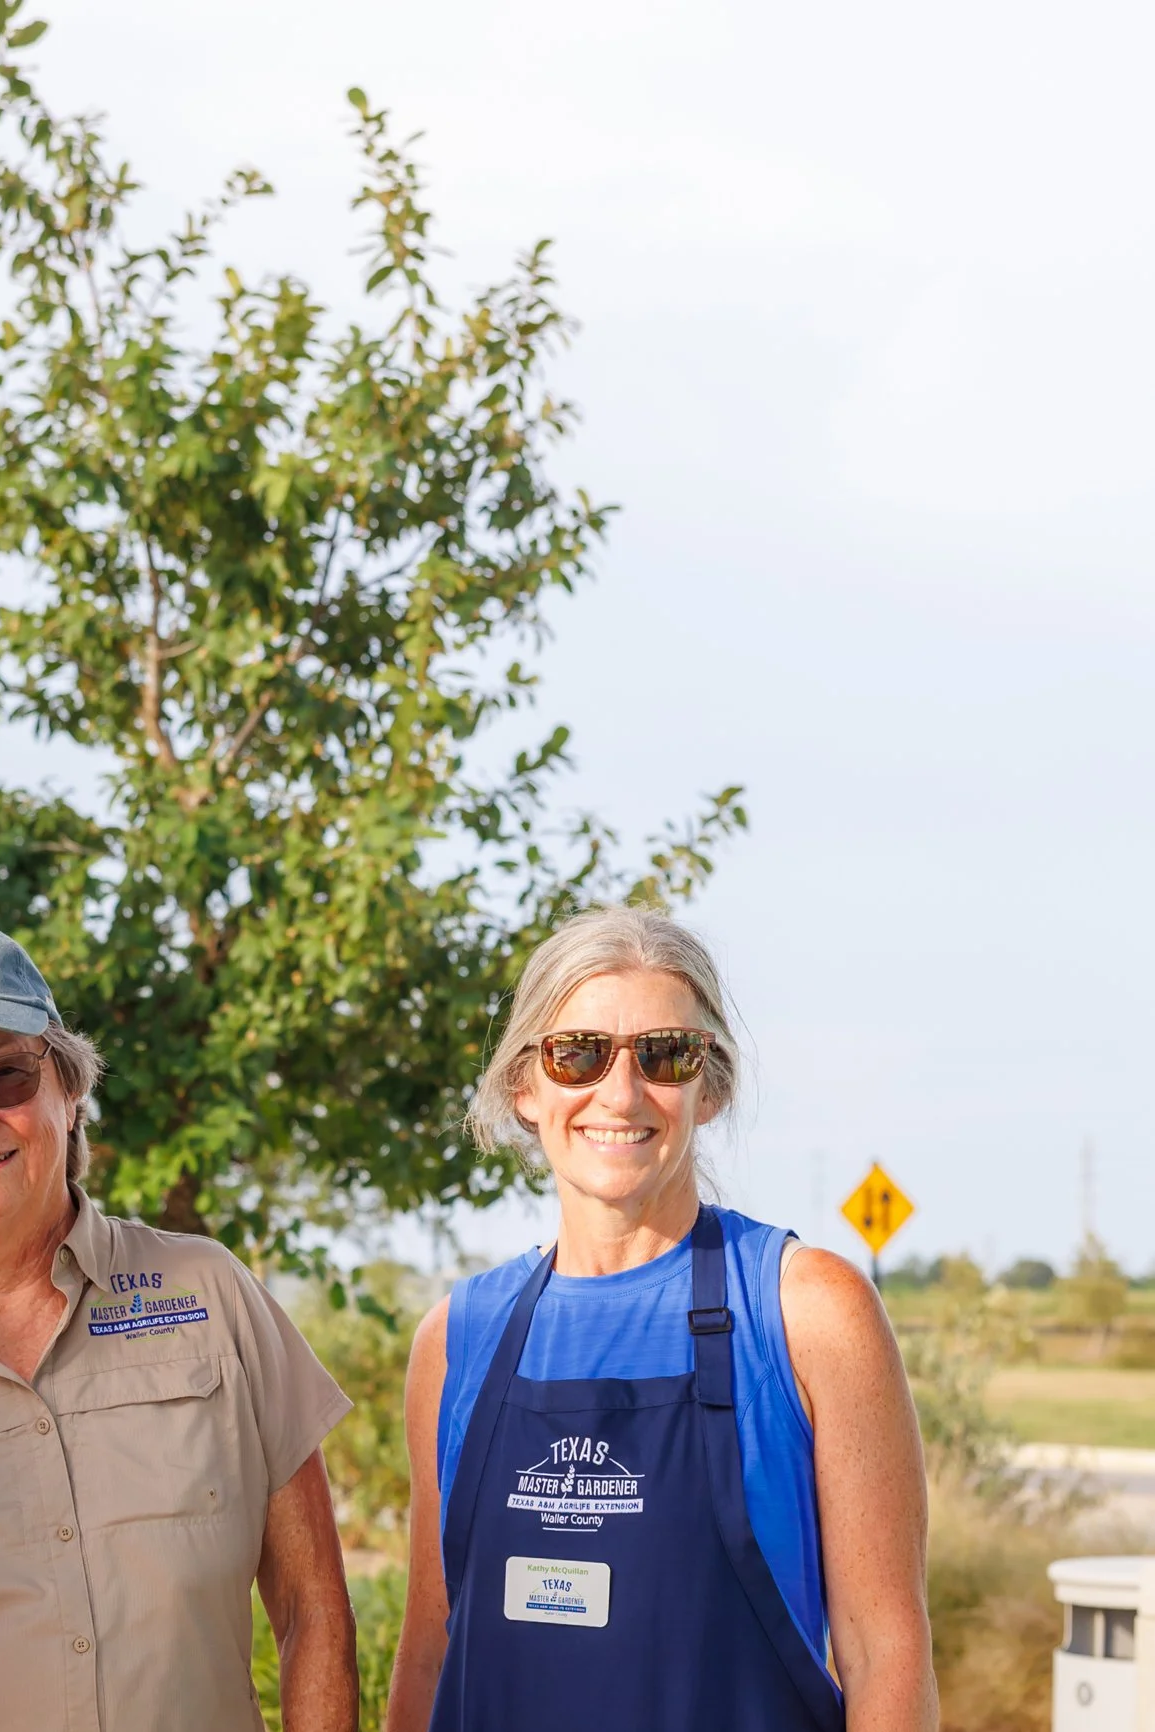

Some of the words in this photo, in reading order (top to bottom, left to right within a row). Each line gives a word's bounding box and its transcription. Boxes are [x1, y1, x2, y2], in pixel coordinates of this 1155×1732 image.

[110, 1272, 163, 1294] TEXAS
[90, 1305, 127, 1321] MASTER
[144, 1294, 198, 1314] GARDENER
[92, 1325, 112, 1334] TEXAS
[114, 1323, 131, 1332] A&M
[132, 1316, 164, 1328] AGRILIFE
[164, 1312, 206, 1324] EXTENSION
[125, 1331, 146, 1340] Waller
[150, 1326, 175, 1336] County
[550, 1436, 610, 1465] TEXAS
[518, 1476, 558, 1494] MASTER
[577, 1480, 638, 1496] GARDENER
[512, 1498, 534, 1506] TEXAS
[538, 1500, 554, 1509] A&M
[558, 1502, 590, 1510] AGRILIFE
[595, 1502, 639, 1510] EXTENSION
[540, 1512, 568, 1524] Waller
[571, 1514, 604, 1527] County
[528, 1564, 550, 1574] Kathy
[551, 1566, 588, 1576] McQuillan
[542, 1579, 572, 1592] TEXAS
[529, 1594, 549, 1602] MASTER
